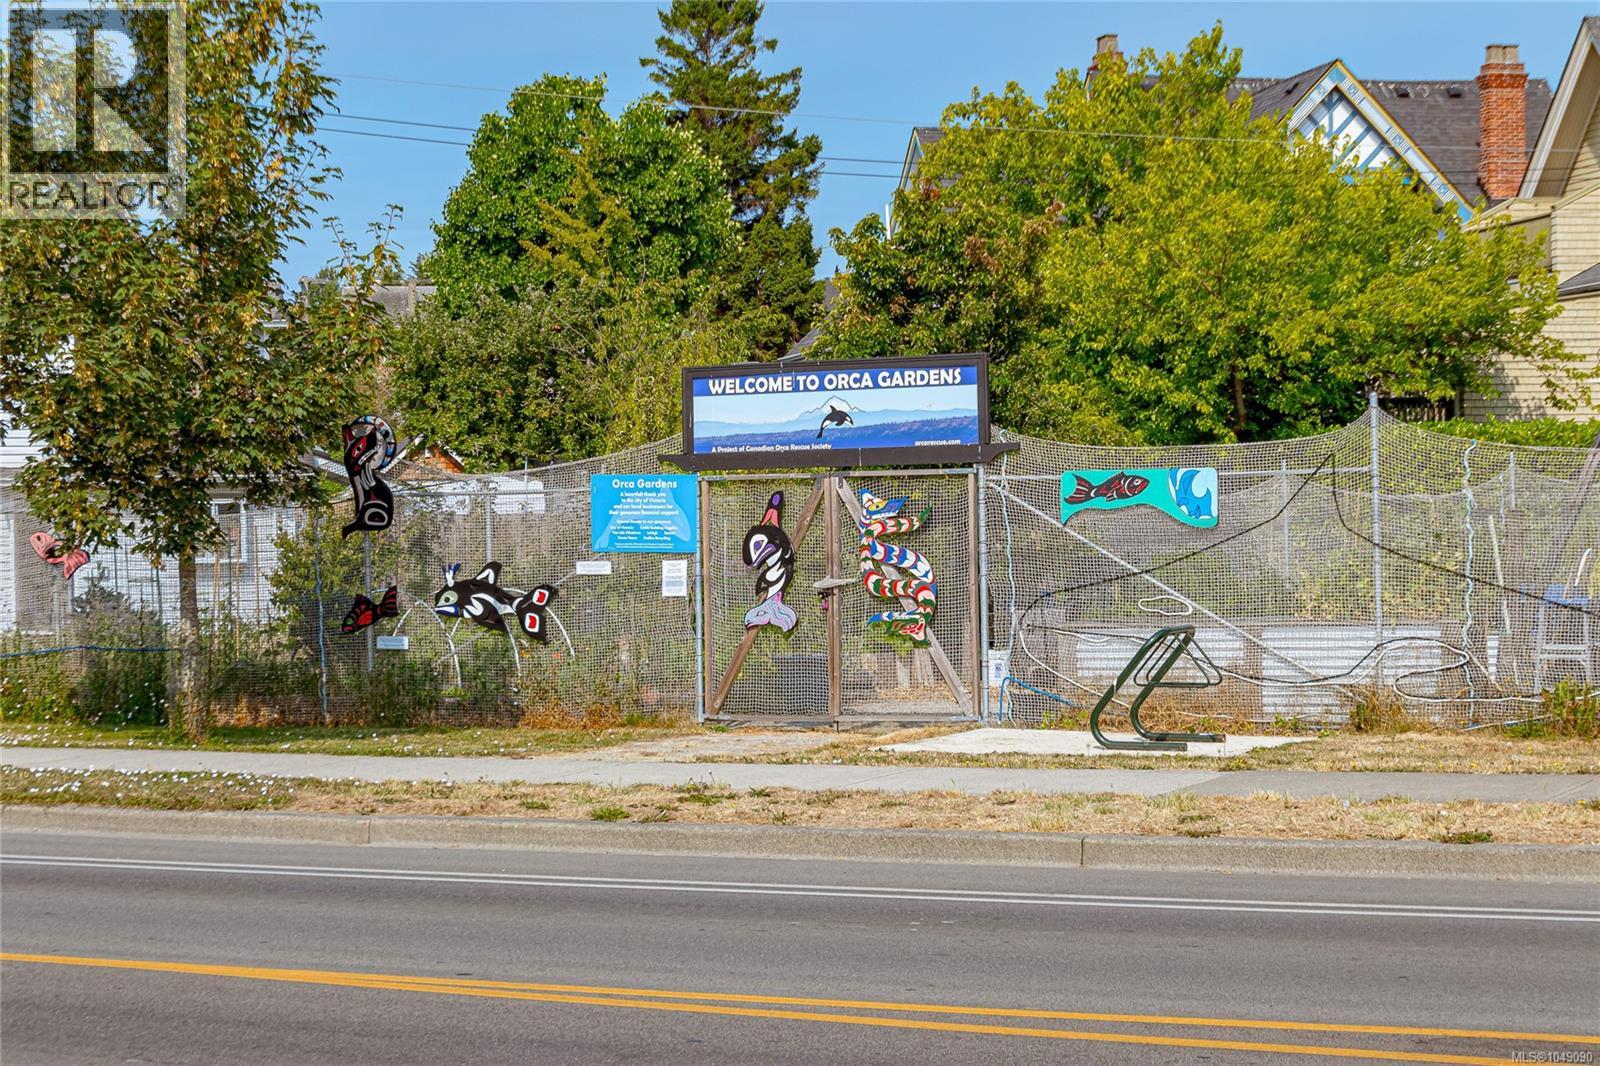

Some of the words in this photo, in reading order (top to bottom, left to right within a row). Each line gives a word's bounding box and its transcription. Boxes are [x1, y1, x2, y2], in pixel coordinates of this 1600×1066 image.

[708, 376, 792, 394] WELCOME
[796, 374, 820, 390] TO
[824, 372, 873, 390] ORCA
[878, 368, 961, 387] GARDENS
[612, 479, 634, 488] Orca
[637, 478, 678, 488] Gardens
